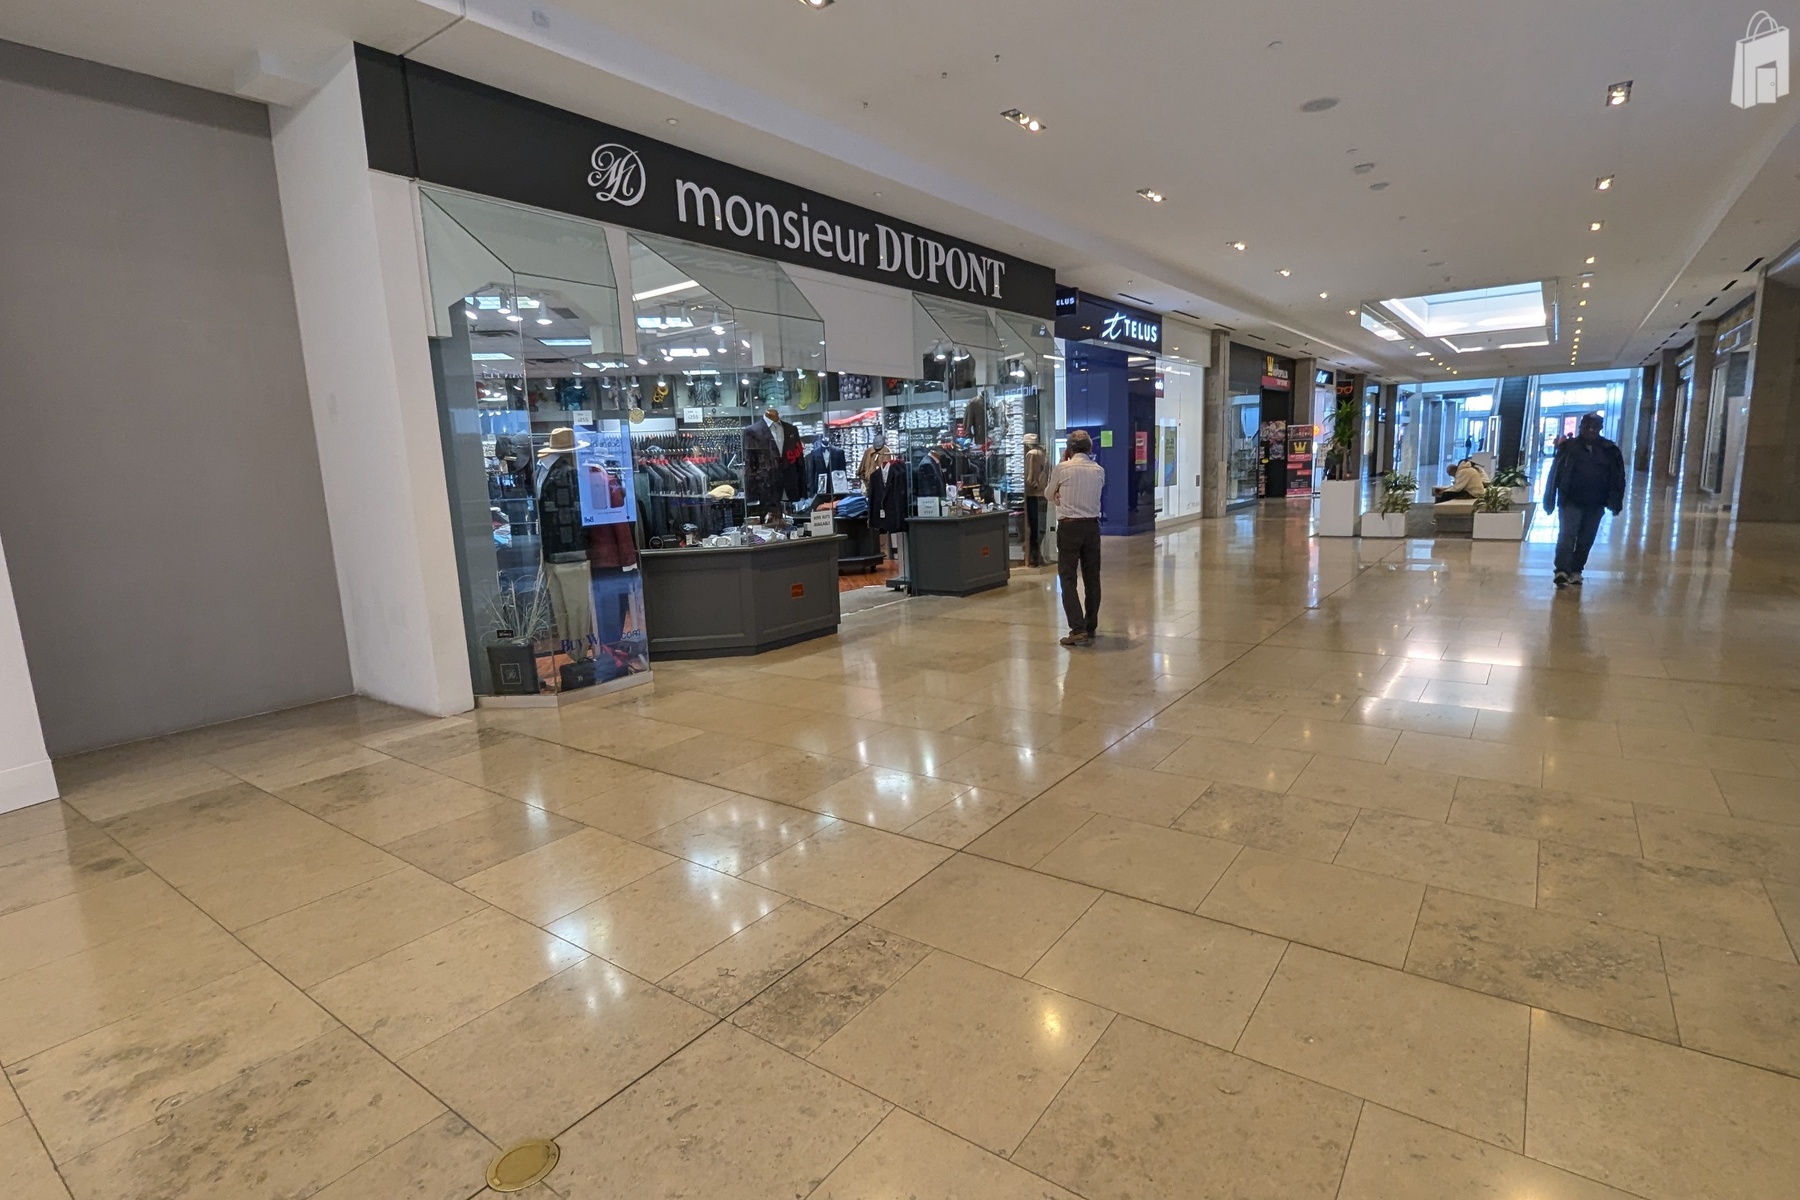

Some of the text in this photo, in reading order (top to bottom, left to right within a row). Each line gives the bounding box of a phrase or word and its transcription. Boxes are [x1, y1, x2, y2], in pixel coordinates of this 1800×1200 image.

[676, 179, 1006, 299] monsieur DUPONT
[1056, 297, 1075, 306] ELUS
[1124, 319, 1157, 343] TELUS
